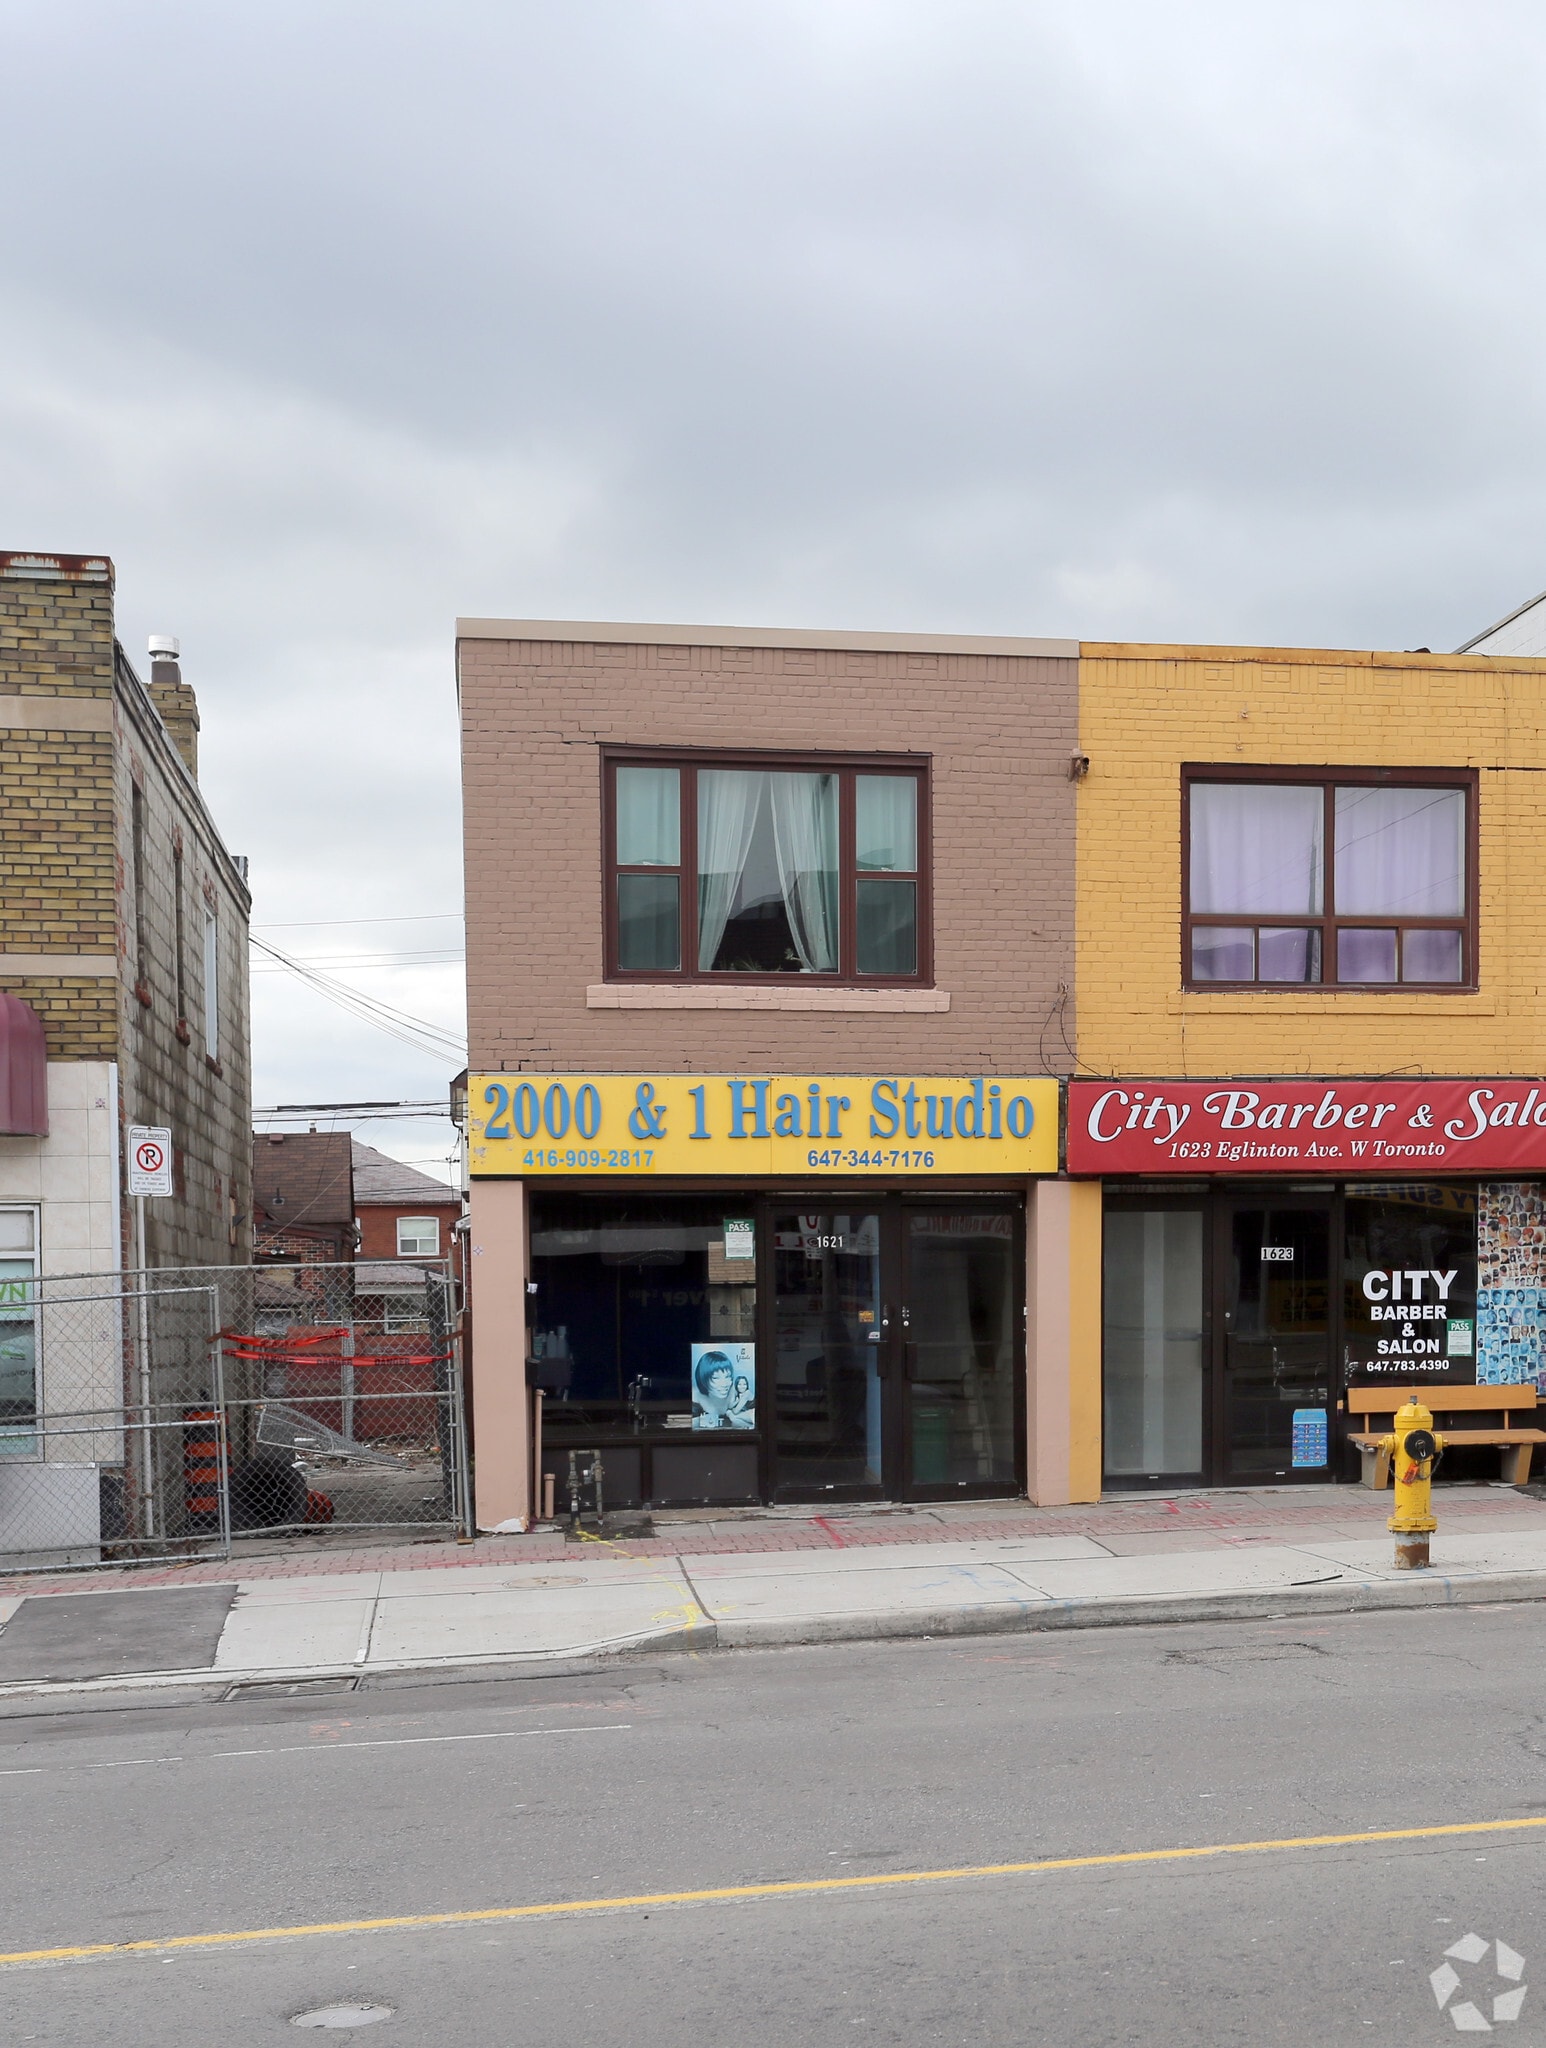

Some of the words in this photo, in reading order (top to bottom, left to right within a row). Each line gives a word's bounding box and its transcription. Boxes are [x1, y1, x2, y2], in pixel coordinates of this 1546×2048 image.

[484, 1083, 602, 1139] 2000
[628, 1081, 667, 1139] &
[688, 1084, 711, 1139] 1
[727, 1080, 851, 1138] Hair
[869, 1078, 1034, 1139] Studio
[1087, 1089, 1191, 1144] City
[1202, 1089, 1396, 1129] Barber
[1407, 1103, 1434, 1128] &
[523, 1149, 654, 1167] 416-909-2817
[1168, 1142, 1212, 1158] 1623
[1216, 1141, 1299, 1161] Eglinton
[1304, 1141, 1343, 1157] Ave.
[1350, 1140, 1370, 1157] W
[1371, 1140, 1446, 1157] Toronto
[807, 1150, 935, 1167] 647-344-7176
[729, 1223, 750, 1232] PASS
[817, 1235, 843, 1248] 1621
[1262, 1248, 1293, 1260] 1623
[1362, 1270, 1458, 1300] CITY
[1370, 1305, 1447, 1320] BARBER
[1401, 1322, 1416, 1337] &
[1451, 1322, 1469, 1331] PASS
[1377, 1339, 1440, 1354] SALON
[374, 1357, 411, 1366] DANGER
[1366, 1360, 1450, 1371] 647.783.4390
